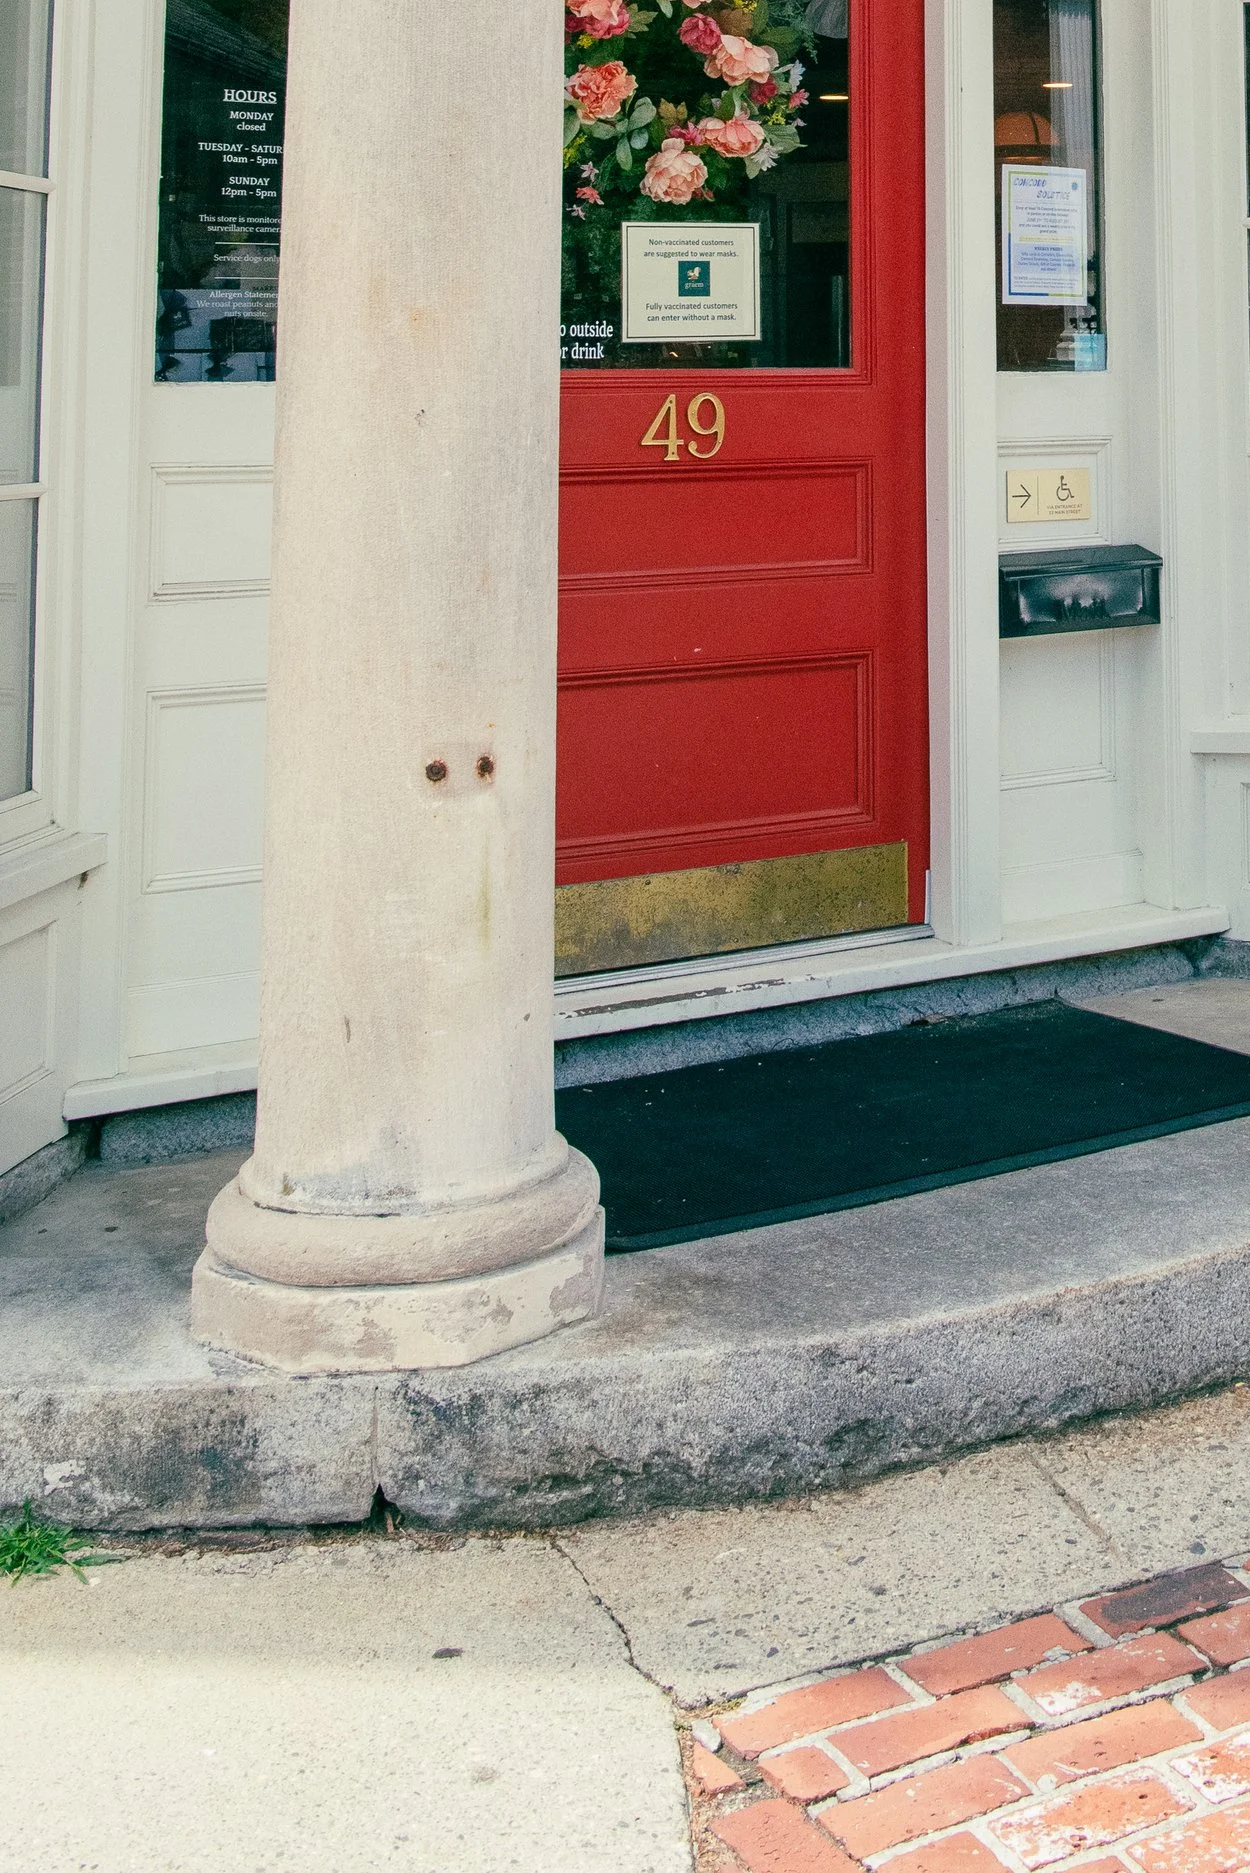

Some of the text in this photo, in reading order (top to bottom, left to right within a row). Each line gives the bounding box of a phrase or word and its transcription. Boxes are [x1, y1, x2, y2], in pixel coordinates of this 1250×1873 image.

[222, 88, 277, 104] HOURS
[230, 111, 274, 121] MONDAY
[236, 122, 266, 131] closed
[198, 142, 243, 152] TUESDAY
[222, 154, 247, 163] 10am
[256, 156, 278, 166] 5pm
[229, 176, 270, 186] SUNDAY
[221, 187, 247, 198] 12pm
[255, 188, 277, 199] 5pm
[198, 214, 216, 222] This
[207, 224, 254, 232] surveillance
[648, 238, 734, 246] Non-vaccinated customers
[214, 254, 242, 262] Service
[244, 254, 262, 263] dogs
[656, 249, 688, 259] suggested
[209, 290, 242, 300] Allergen
[196, 300, 210, 308] We
[232, 301, 263, 310] peanuts
[646, 302, 663, 311] Fully
[664, 302, 701, 310] vaccinated
[682, 313, 709, 321] without
[716, 313, 736, 321] mask.
[569, 320, 614, 337] outside
[571, 342, 605, 359] drink
[641, 392, 726, 461] 49
